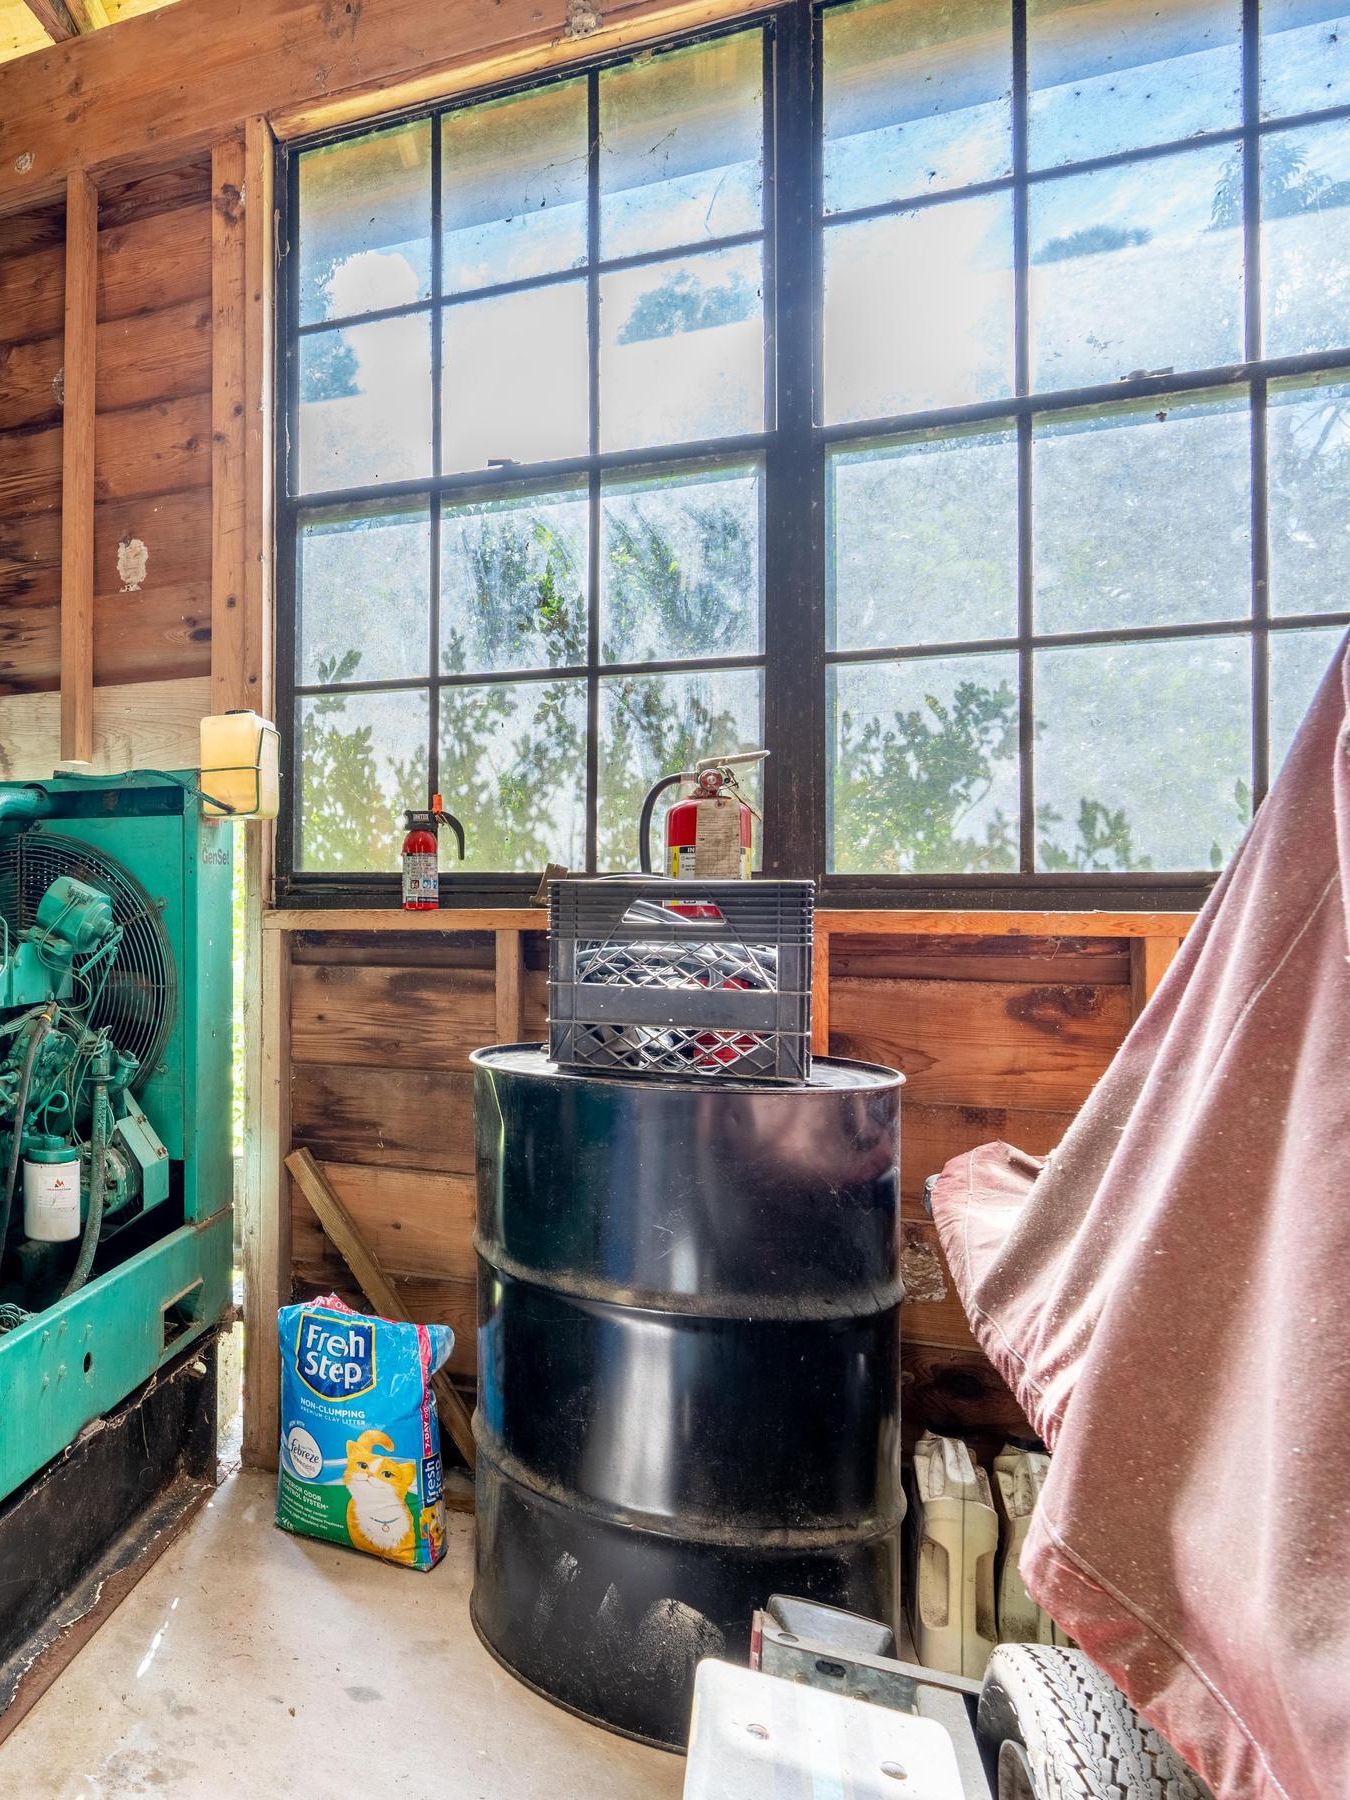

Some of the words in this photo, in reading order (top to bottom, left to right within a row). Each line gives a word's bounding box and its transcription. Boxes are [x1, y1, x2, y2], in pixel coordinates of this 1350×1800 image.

[300, 1397, 365, 1419] NON-CLUMPING
[300, 1406, 323, 1418] PREMIUM
[324, 1414, 340, 1423] CLAY
[341, 1418, 366, 1426] LITTER
[424, 1421, 432, 1450] 7-DAY
[291, 1438, 320, 1463] febreze
[282, 1481, 302, 1500] CONTROL
[303, 1489, 322, 1502] ODOR
